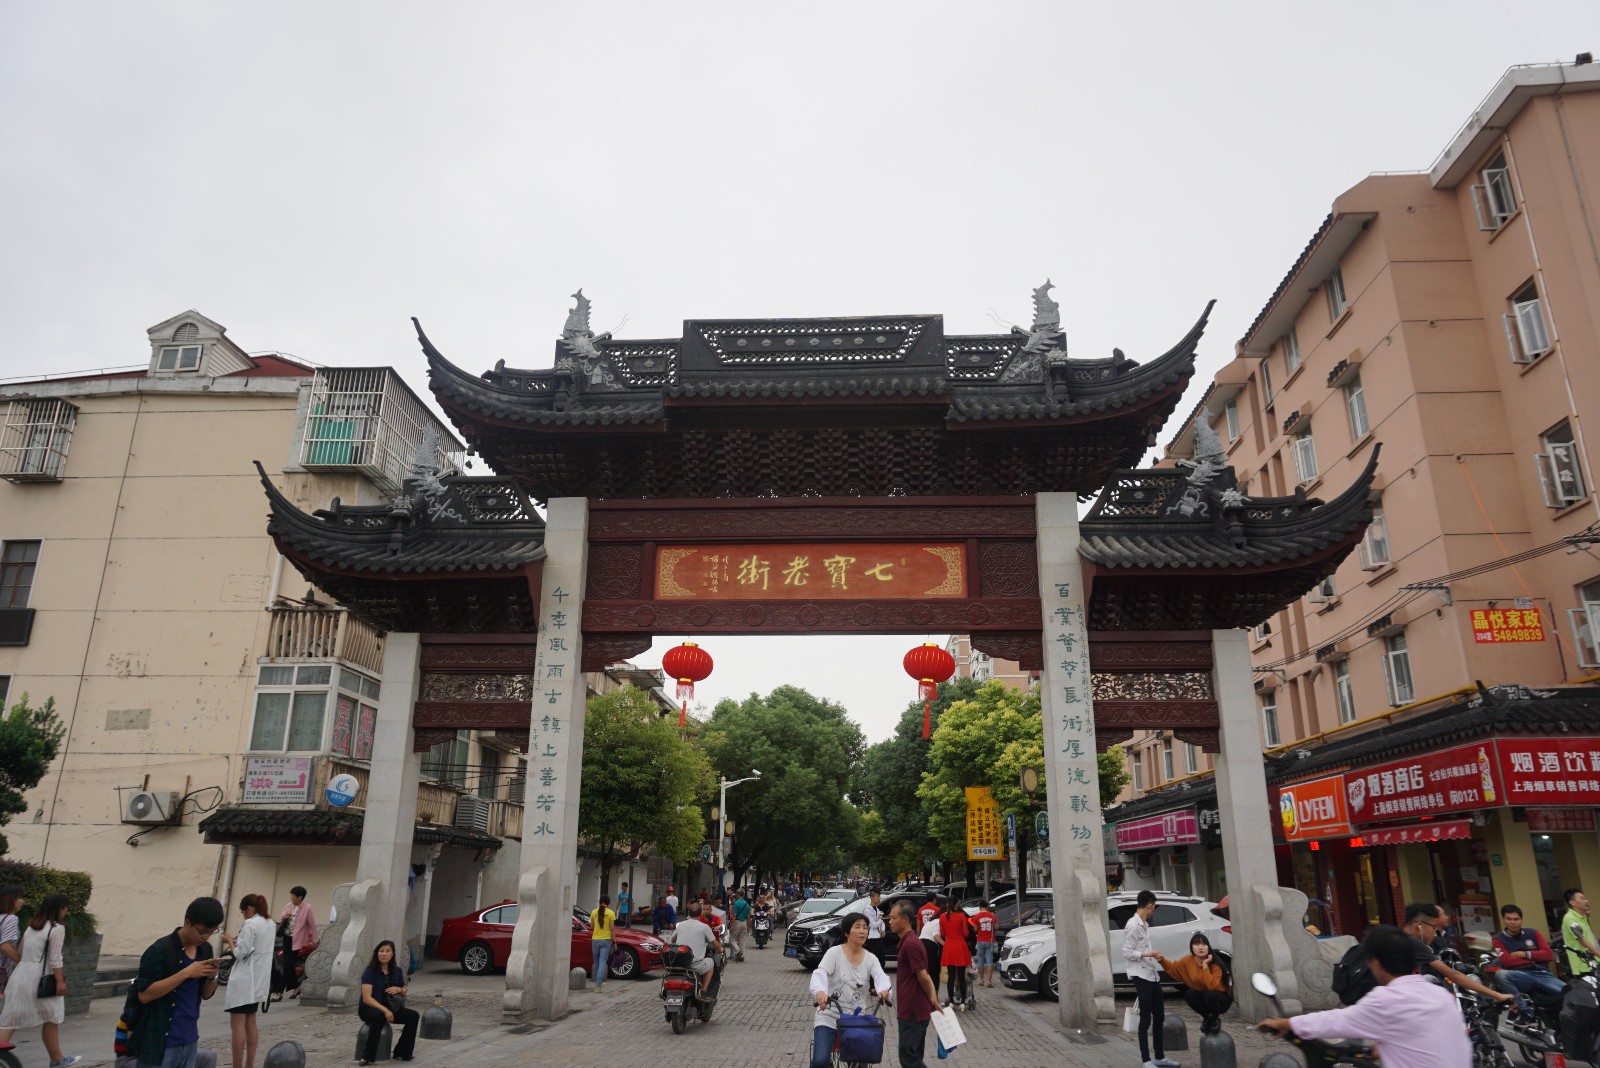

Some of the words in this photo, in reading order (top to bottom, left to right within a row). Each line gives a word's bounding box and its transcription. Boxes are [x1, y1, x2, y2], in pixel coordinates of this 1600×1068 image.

[1473, 610, 1541, 630] 晶悦家政
[1493, 629, 1543, 641] 54849839
[1367, 764, 1425, 798] 烟酒商店
[1298, 795, 1336, 823] LYFEN
[1373, 792, 1446, 816] 上海烟草销售网络单位
